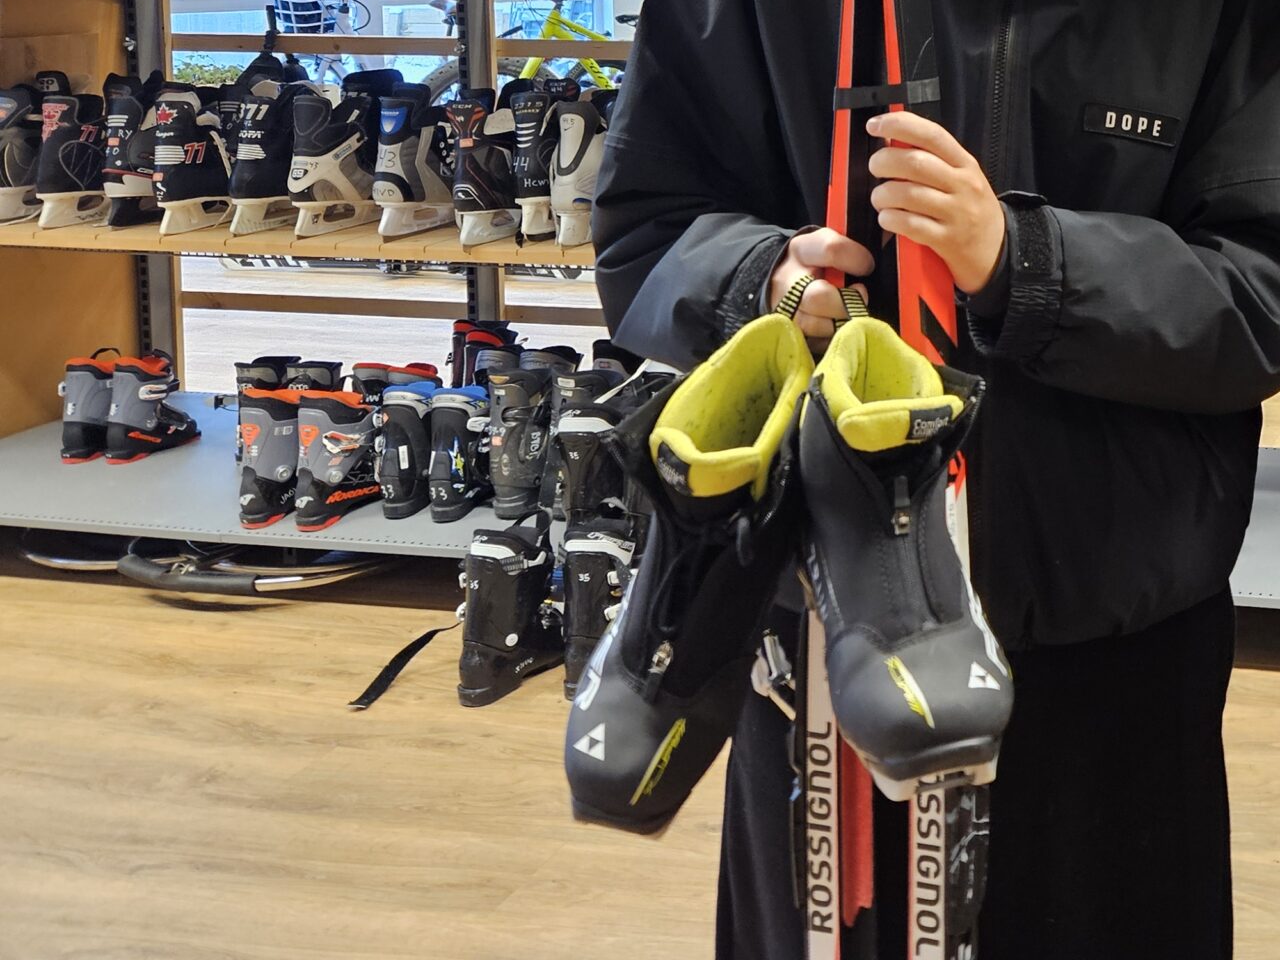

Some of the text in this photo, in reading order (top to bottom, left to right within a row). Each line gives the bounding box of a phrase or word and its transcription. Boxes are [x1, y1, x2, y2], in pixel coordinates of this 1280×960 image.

[1105, 111, 1162, 137] DOPE
[378, 148, 397, 169] 43
[512, 156, 530, 172] 44
[577, 572, 591, 582] 35
[806, 721, 834, 934] ROSSIGNOL
